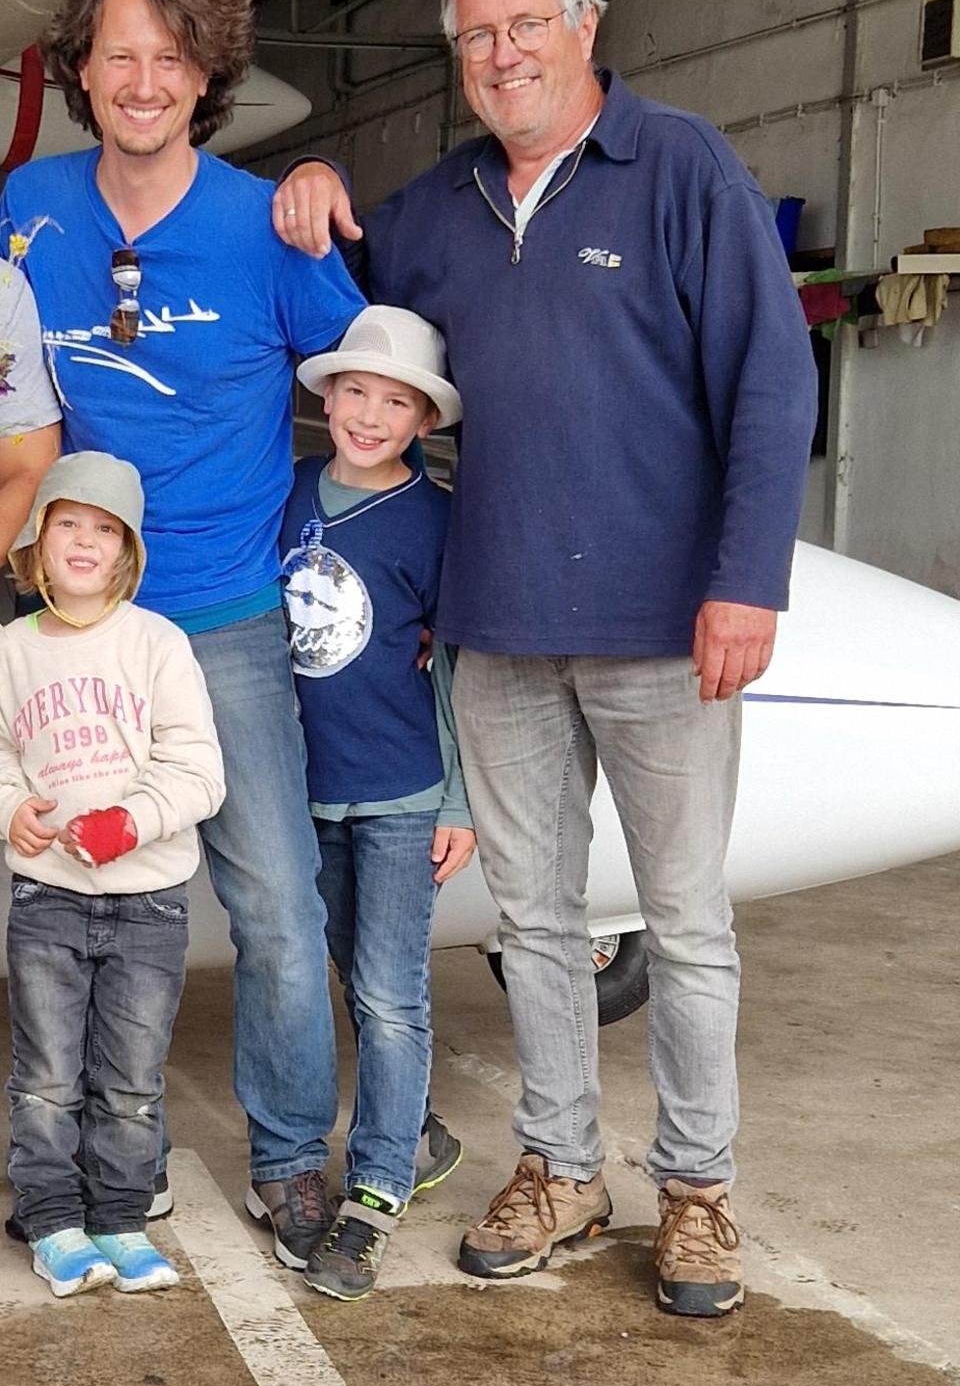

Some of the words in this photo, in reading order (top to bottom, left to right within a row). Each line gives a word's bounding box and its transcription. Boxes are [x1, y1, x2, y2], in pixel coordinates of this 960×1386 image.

[14, 677, 146, 757] EVERYDAY
[52, 724, 108, 753] 1998
[37, 758, 83, 779] always
[90, 747, 131, 765] happ
